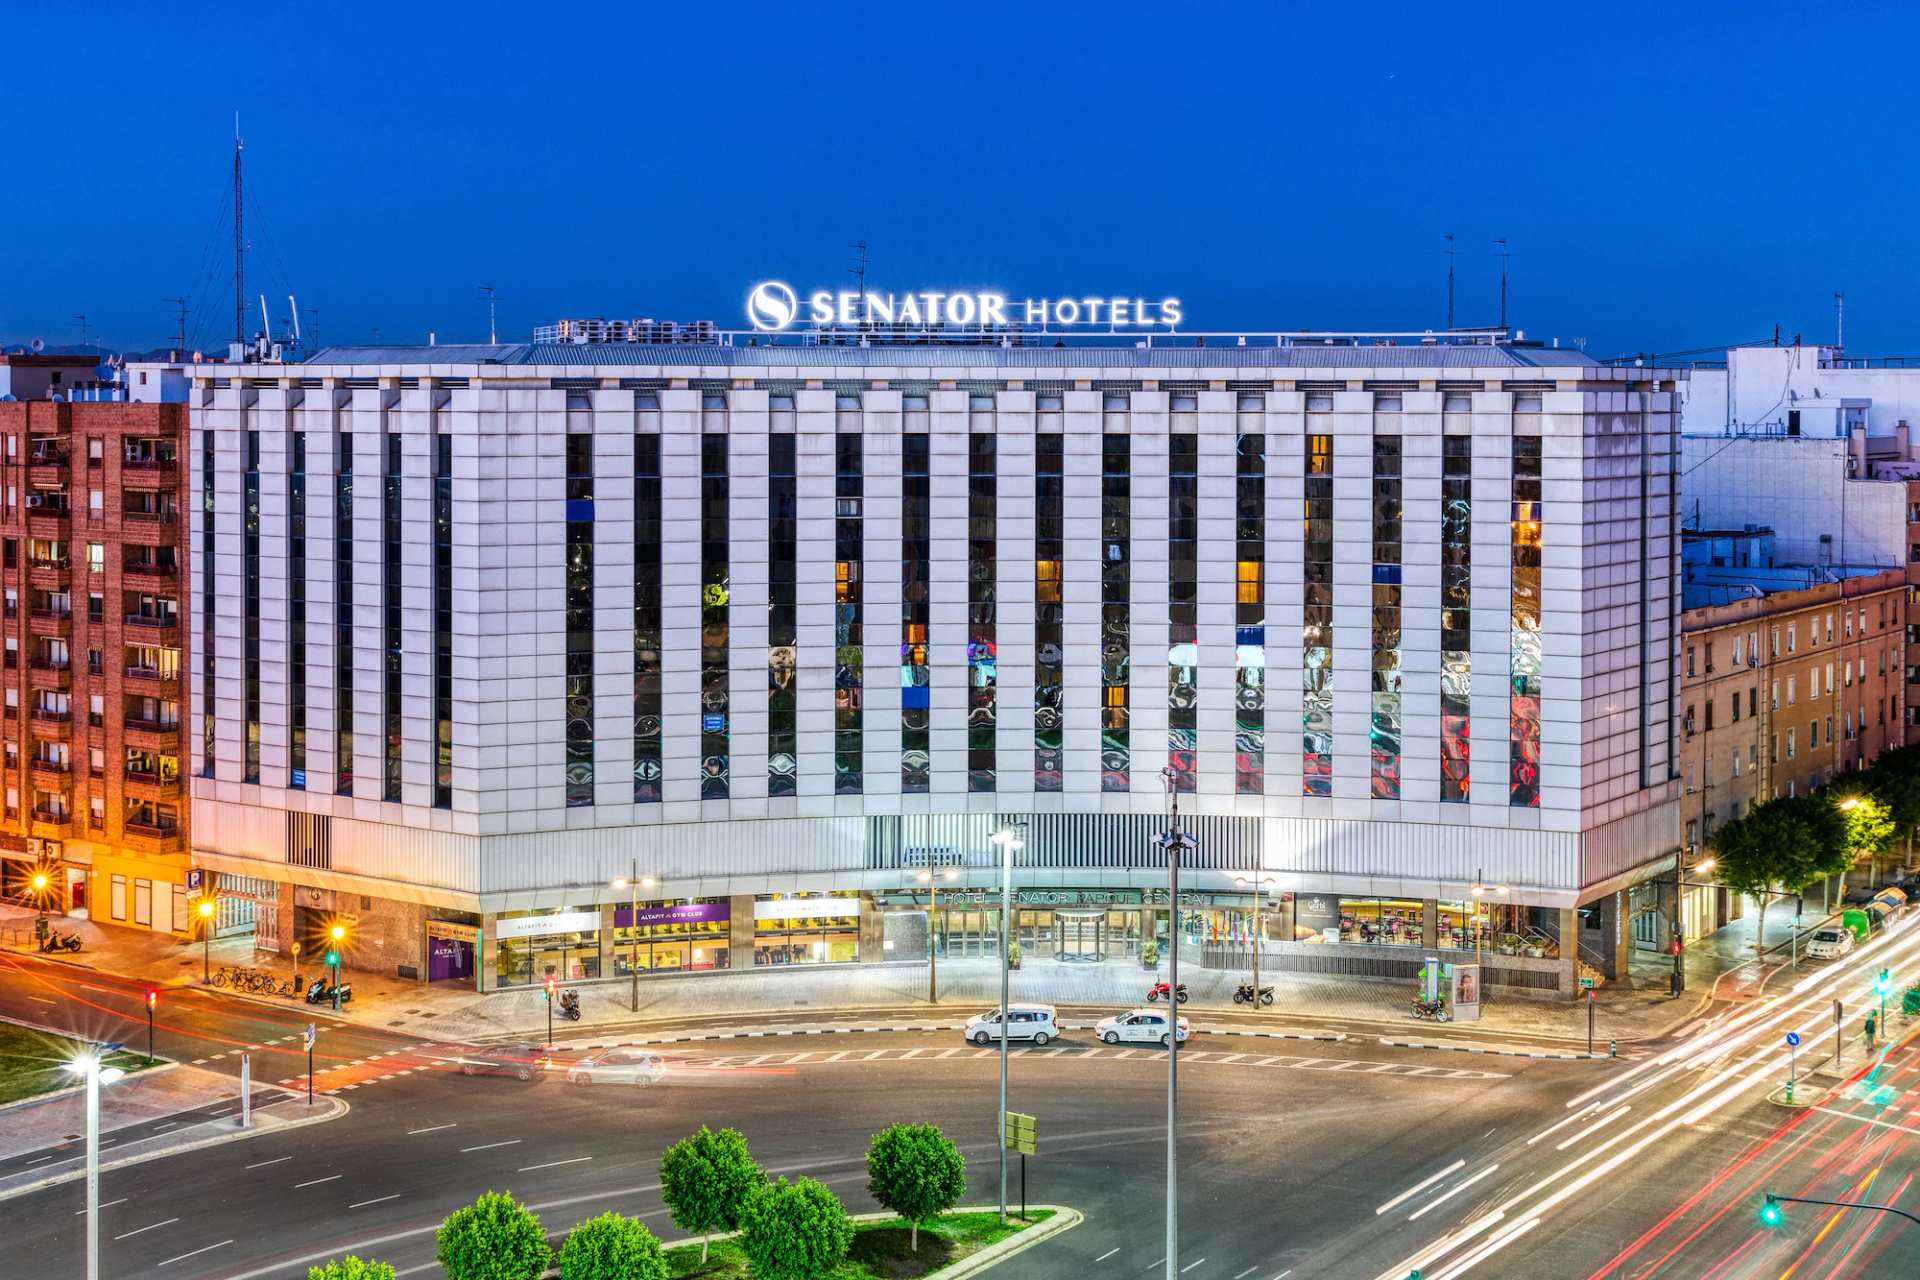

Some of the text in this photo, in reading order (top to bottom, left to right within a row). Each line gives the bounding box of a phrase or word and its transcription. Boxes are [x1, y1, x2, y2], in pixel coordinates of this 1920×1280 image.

[811, 292, 1182, 325] SENATOR HOTELS
[944, 892, 989, 905] HOTEL
[1076, 892, 1135, 905] PARQUE
[671, 911, 686, 919] GYM
